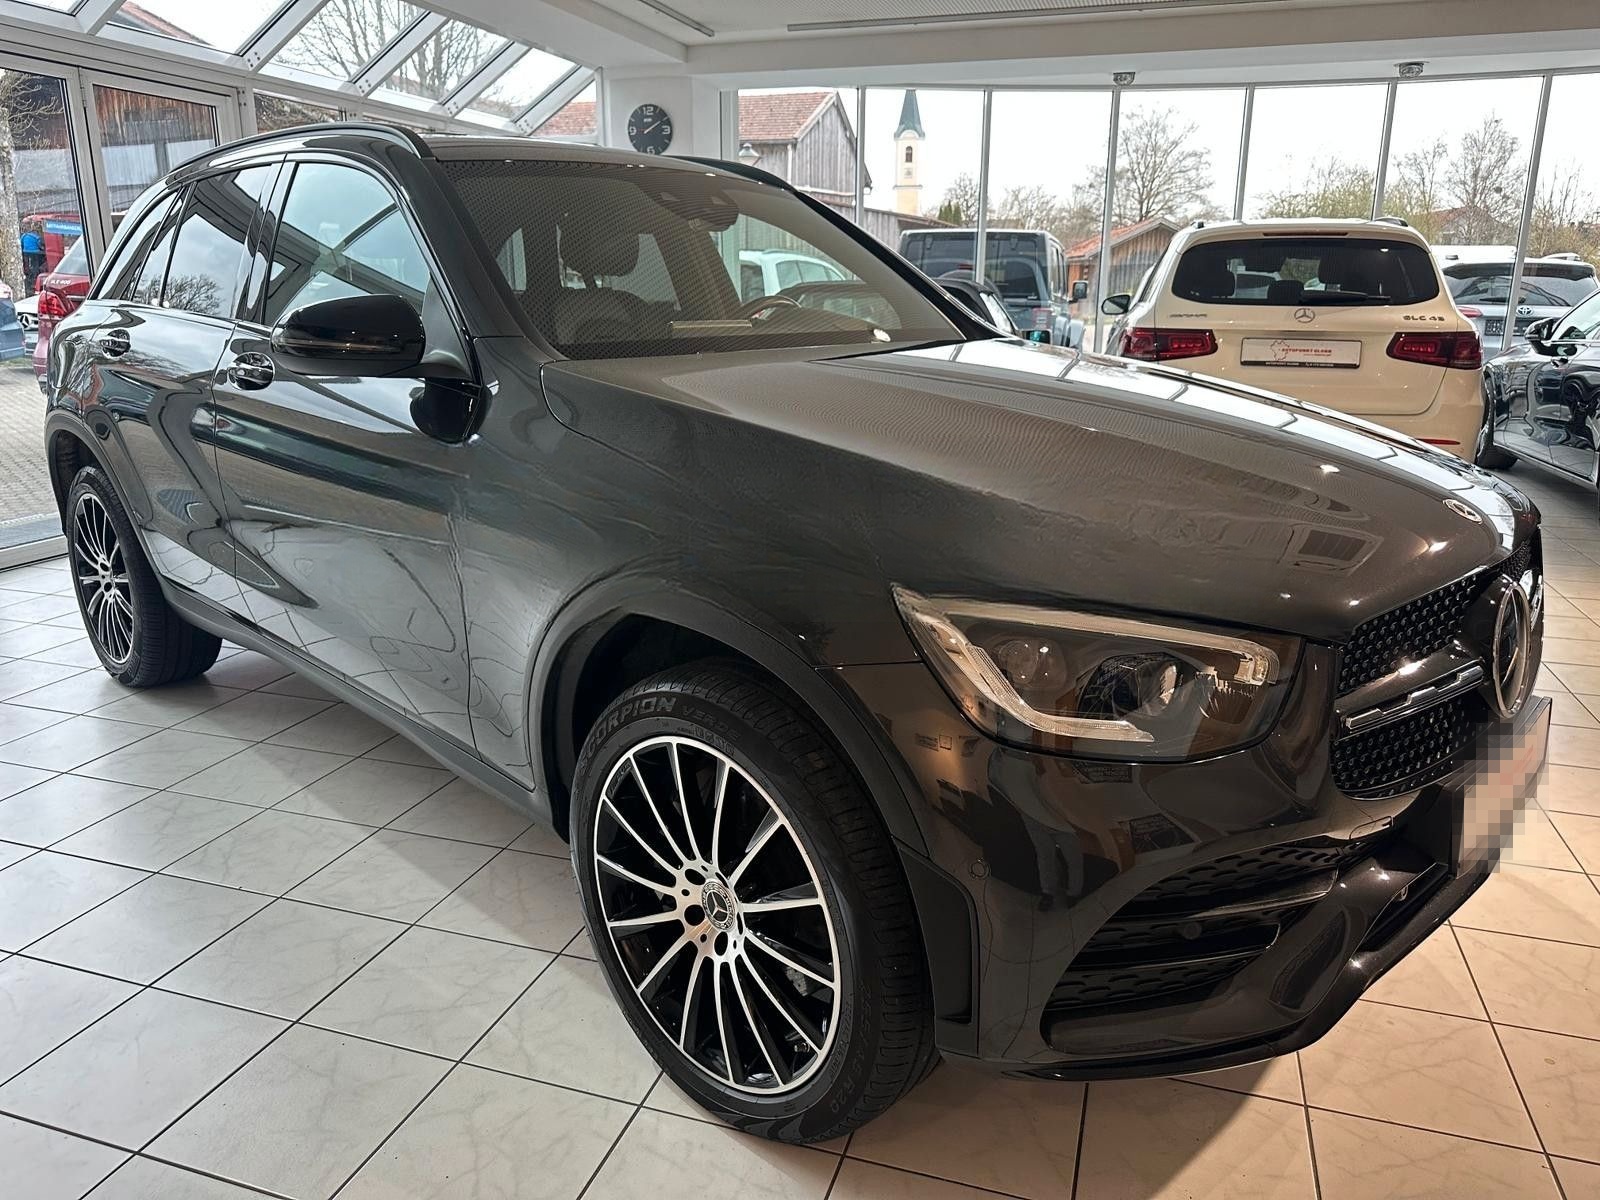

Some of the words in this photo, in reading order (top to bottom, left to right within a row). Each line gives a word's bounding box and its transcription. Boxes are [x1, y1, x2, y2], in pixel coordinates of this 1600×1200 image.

[643, 106, 654, 116] 12
[629, 126, 637, 136] 9
[661, 125, 671, 135] 3
[647, 146, 655, 155] 6
